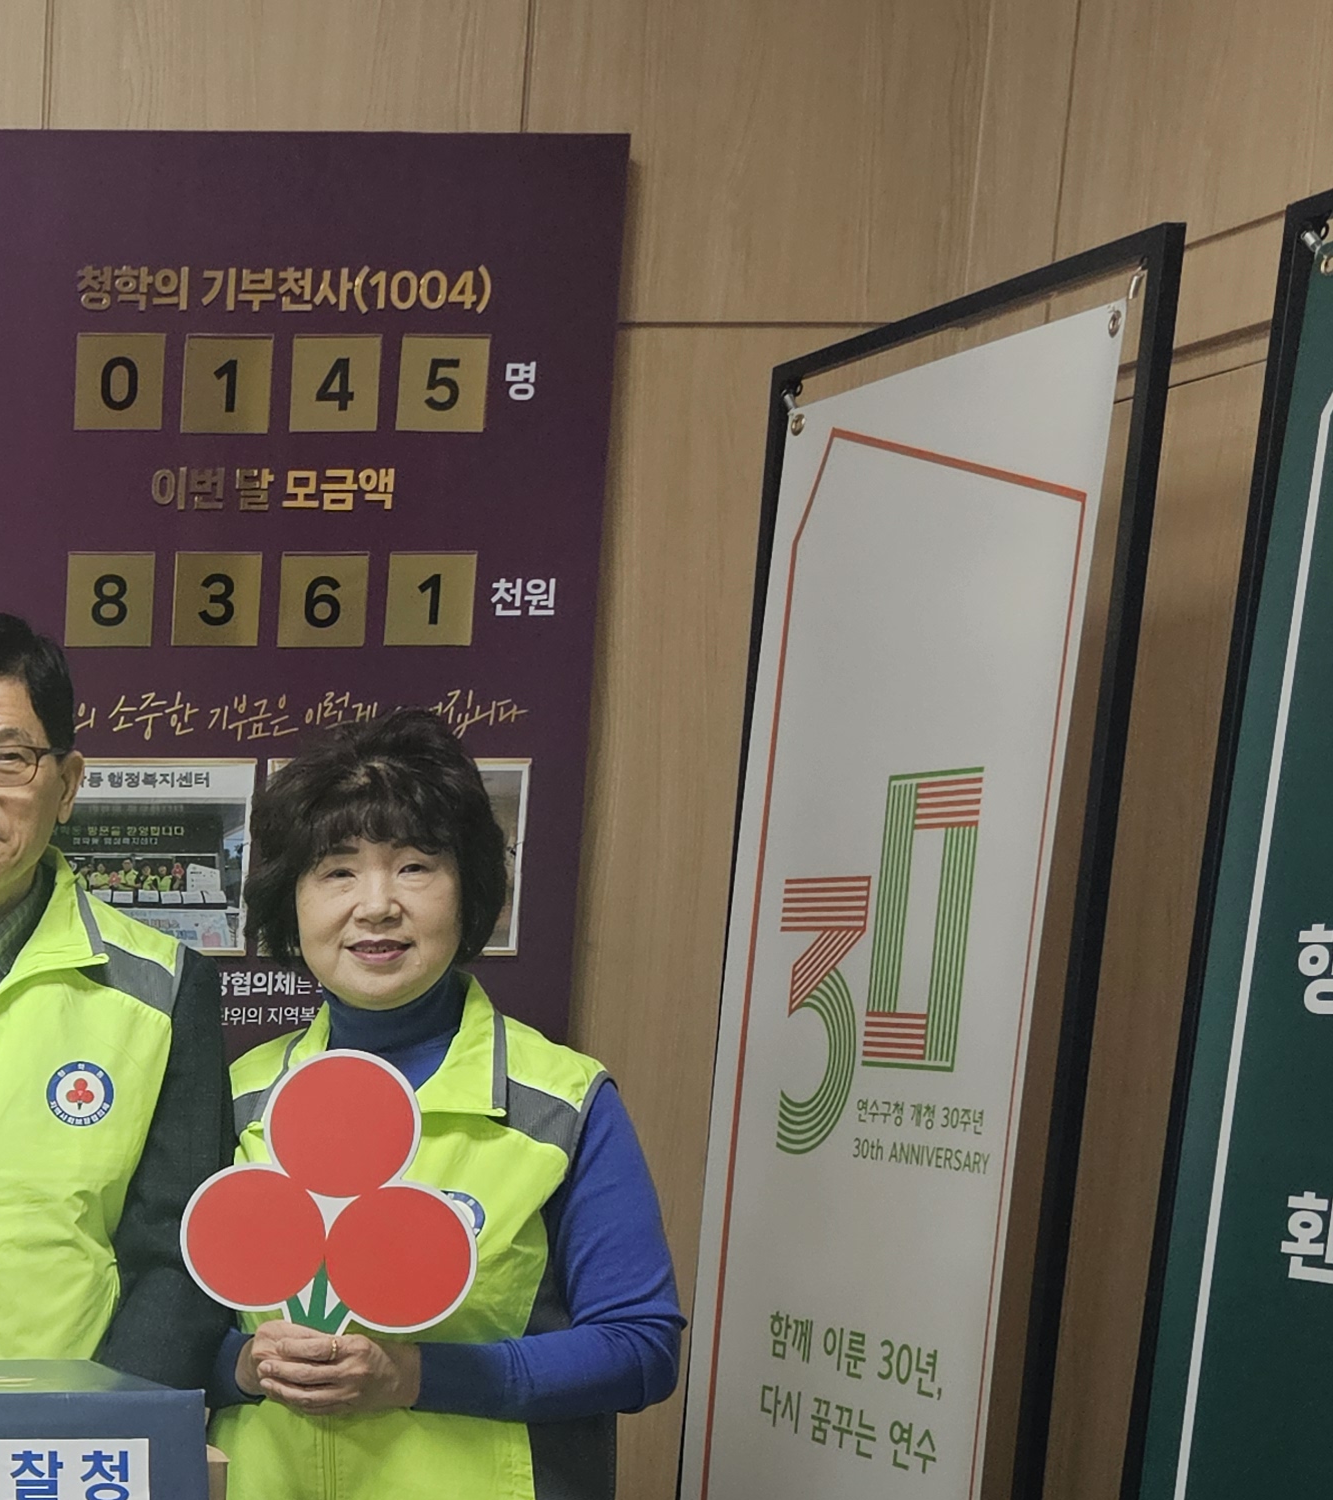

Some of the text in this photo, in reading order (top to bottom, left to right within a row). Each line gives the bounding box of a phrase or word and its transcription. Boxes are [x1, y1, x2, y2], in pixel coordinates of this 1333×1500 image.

[76, 265, 190, 310] 청학의
[504, 361, 537, 402] 명
[151, 466, 396, 511] 이번 달 모금액
[490, 578, 557, 618] 천원
[108, 690, 200, 741] 소중한
[209, 692, 299, 743] 기부금은
[856, 1098, 985, 1135] 연수구청 개청 30주년
[852, 1137, 991, 1175] 30th ANNIVERSARY
[770, 1310, 942, 1400] 함께 이룬 30년,
[760, 1384, 937, 1474] 다시 꿈꾸는 연수
